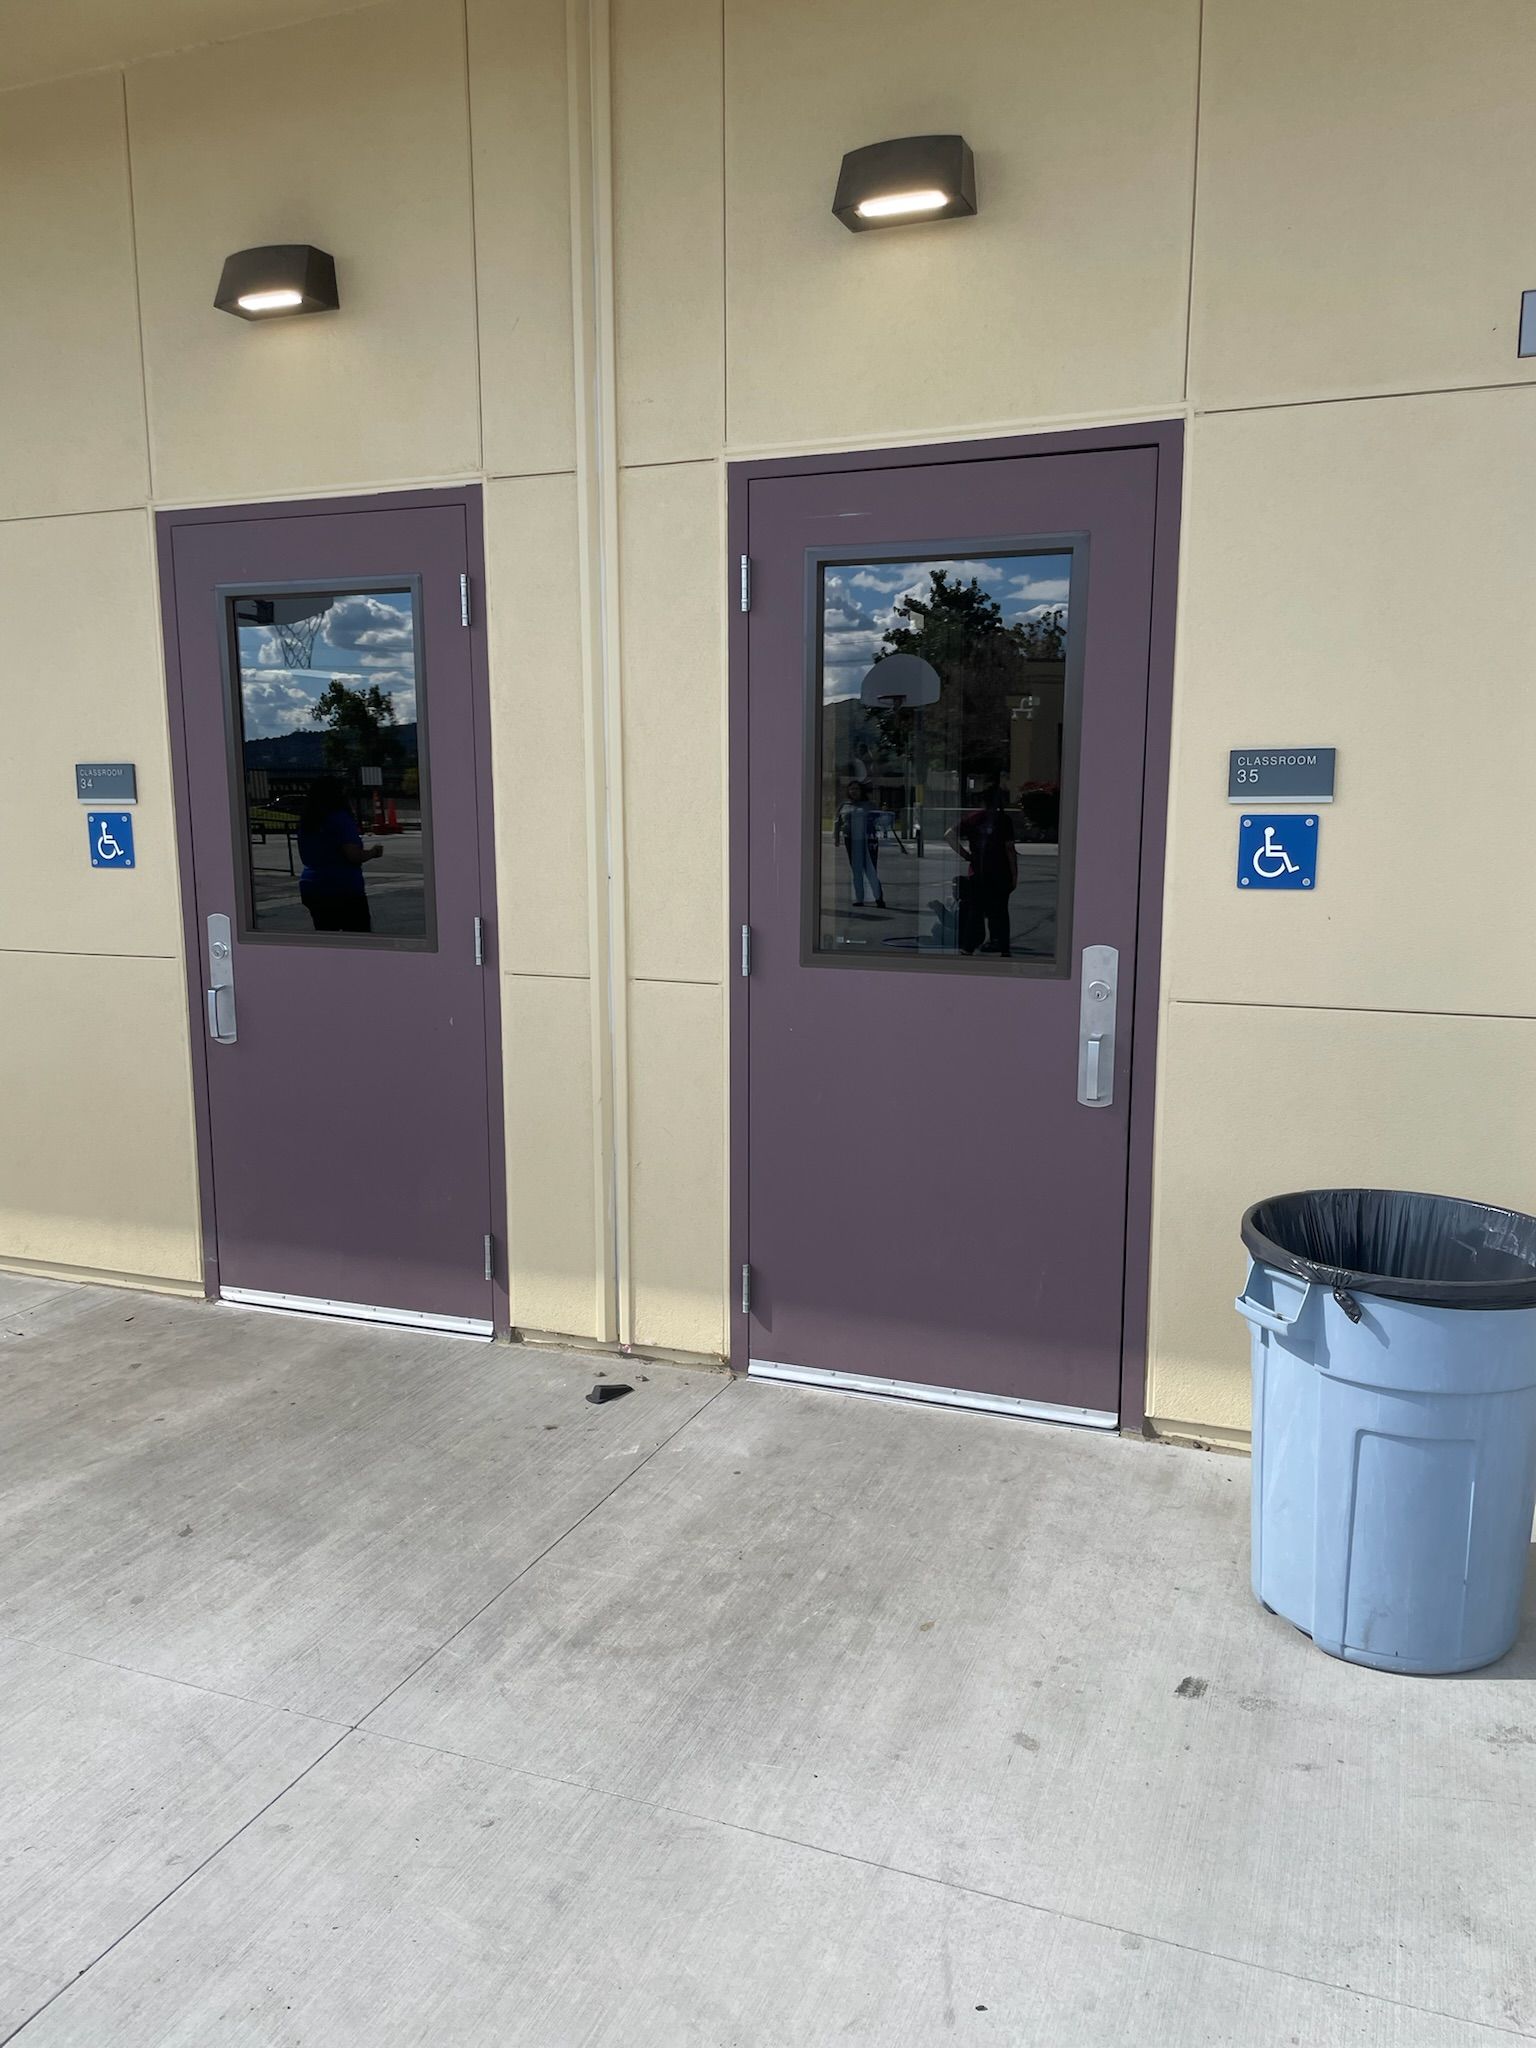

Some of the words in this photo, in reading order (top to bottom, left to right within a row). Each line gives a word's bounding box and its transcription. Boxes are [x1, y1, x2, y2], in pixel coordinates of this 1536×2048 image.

[1237, 756, 1317, 766] CLASSROOM
[80, 768, 123, 777] CLASSROOM
[1237, 769, 1259, 783] 35
[80, 778, 93, 789] 34
